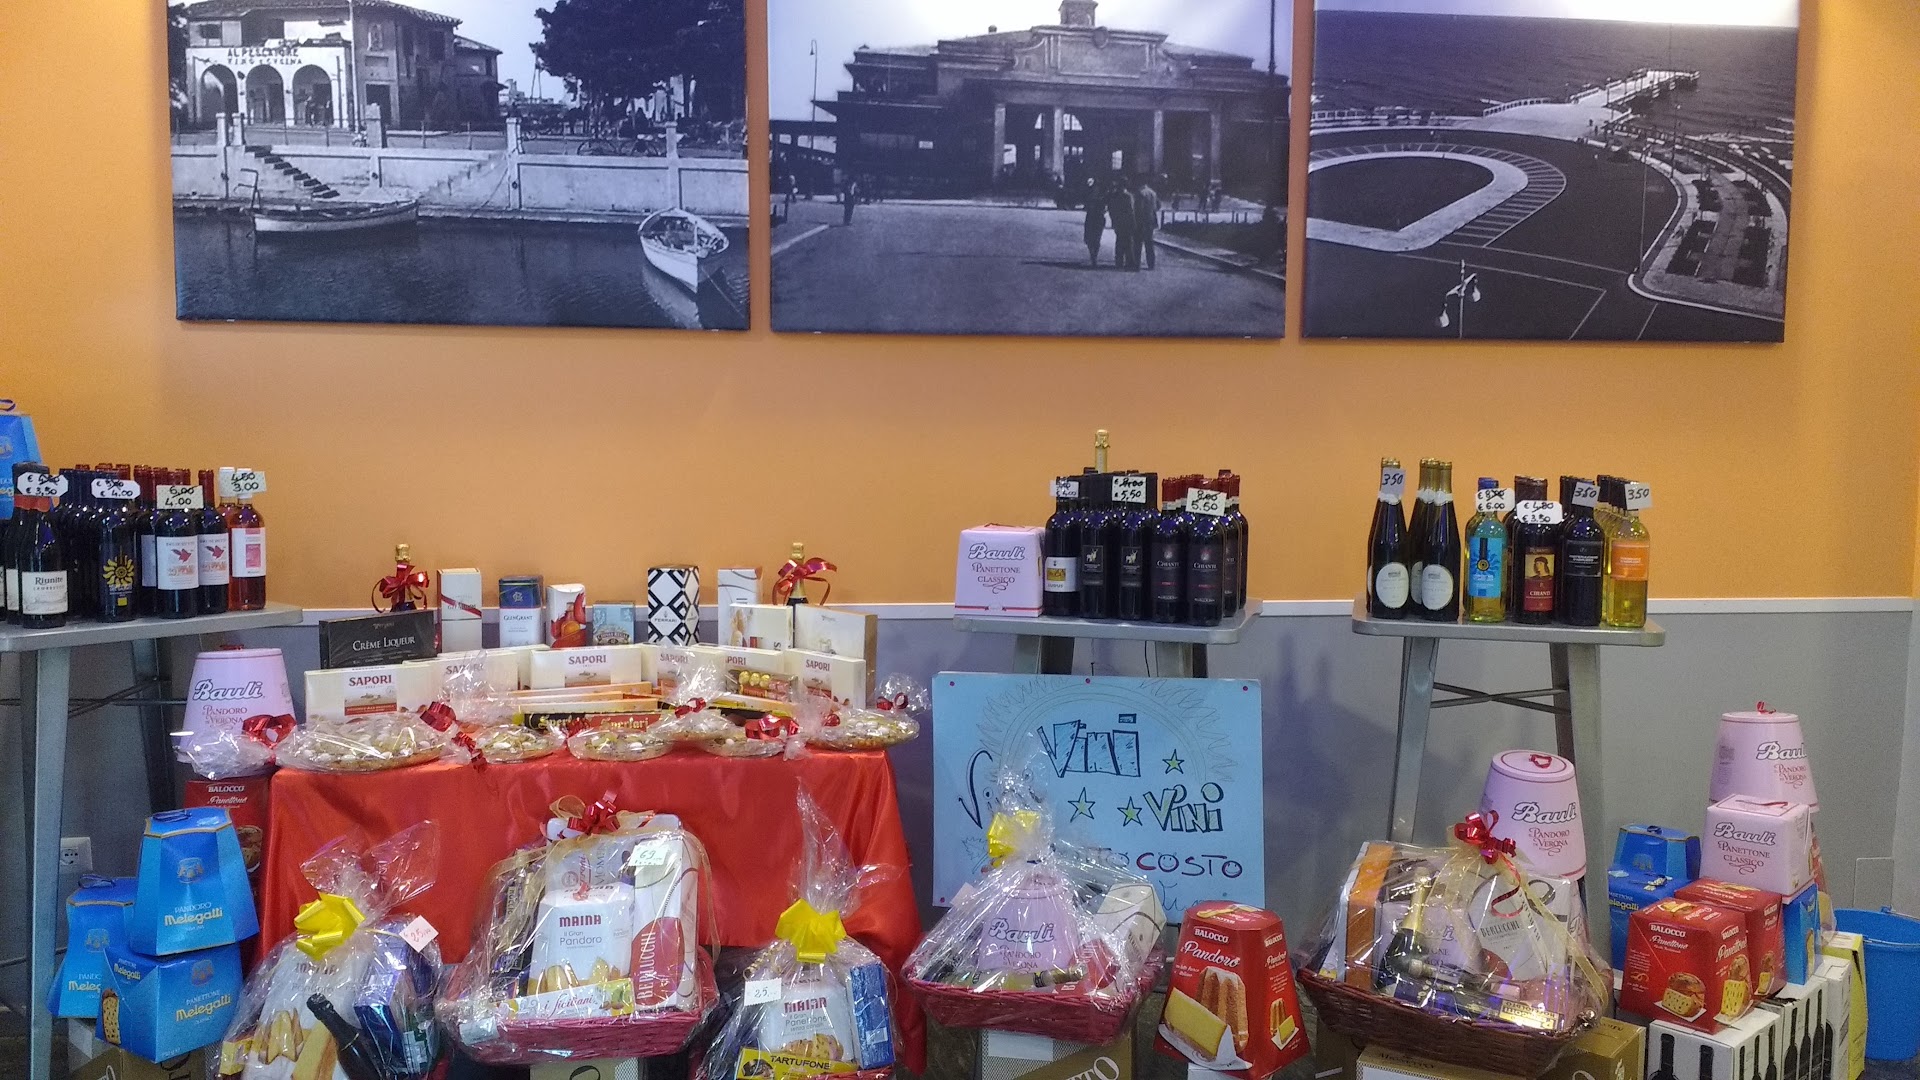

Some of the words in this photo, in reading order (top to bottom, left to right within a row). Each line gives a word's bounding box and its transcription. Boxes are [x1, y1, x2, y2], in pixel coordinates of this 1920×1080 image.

[968, 542, 1026, 561] Bauli
[971, 561, 1021, 574] PANETTONE
[35, 576, 63, 586] Riunite
[977, 575, 1016, 584] CLASSICO
[352, 640, 381, 652] CRÈME
[383, 636, 416, 648] LIQUEUR
[568, 654, 607, 665] SAPORI
[659, 652, 689, 665] SAPORI
[726, 655, 747, 666] PORI
[805, 659, 831, 672] SAPORI
[348, 674, 392, 687] SAPORI
[193, 679, 264, 701] Bauli
[202, 705, 248, 716] PANDORO
[1036, 713, 1142, 778] Vini
[208, 785, 245, 793] BALOCCO
[1511, 801, 1577, 824] Bauli
[1528, 827, 1570, 838] PANDORO
[1713, 821, 1777, 846] Bauli
[1718, 840, 1771, 859] PANETTONE
[1723, 854, 1765, 867] CLASSICO
[164, 907, 223, 926] Melegatti
[988, 917, 1055, 943] Bauli
[1194, 927, 1230, 944] BALOCCO
[1650, 923, 1687, 938] BALOCCO
[559, 935, 603, 947] Pandoro
[1180, 940, 1241, 968] Pandoro
[176, 994, 232, 1021] Melegatti
[770, 1055, 831, 1070] TARTUFONE
